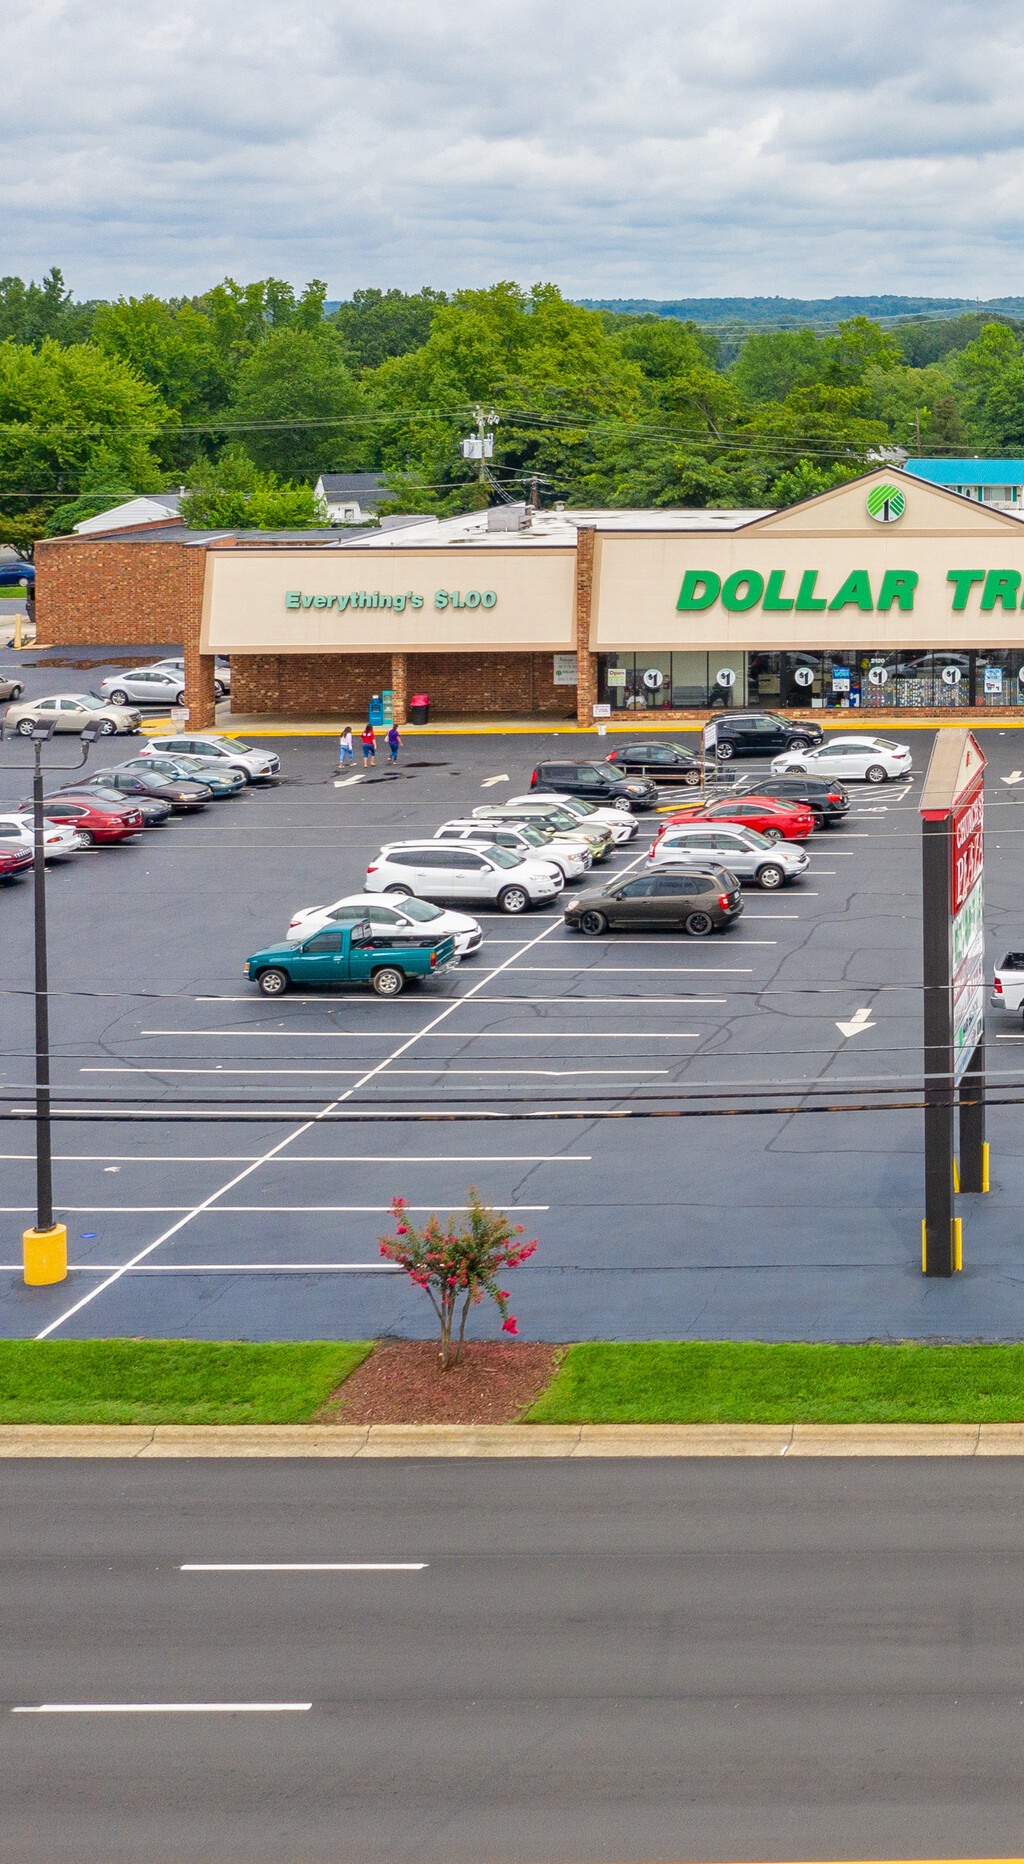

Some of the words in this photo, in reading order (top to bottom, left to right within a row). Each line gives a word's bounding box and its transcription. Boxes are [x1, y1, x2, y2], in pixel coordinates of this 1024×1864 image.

[676, 569, 918, 611] DOLLAR
[286, 591, 423, 612] Everything's
[435, 590, 496, 609] $1.00
[648, 672, 658, 686] $1
[721, 672, 731, 686] $1
[799, 671, 809, 685] $1
[873, 670, 883, 684] $1
[946, 669, 956, 683] $1
[849, 692, 860, 707] $1
